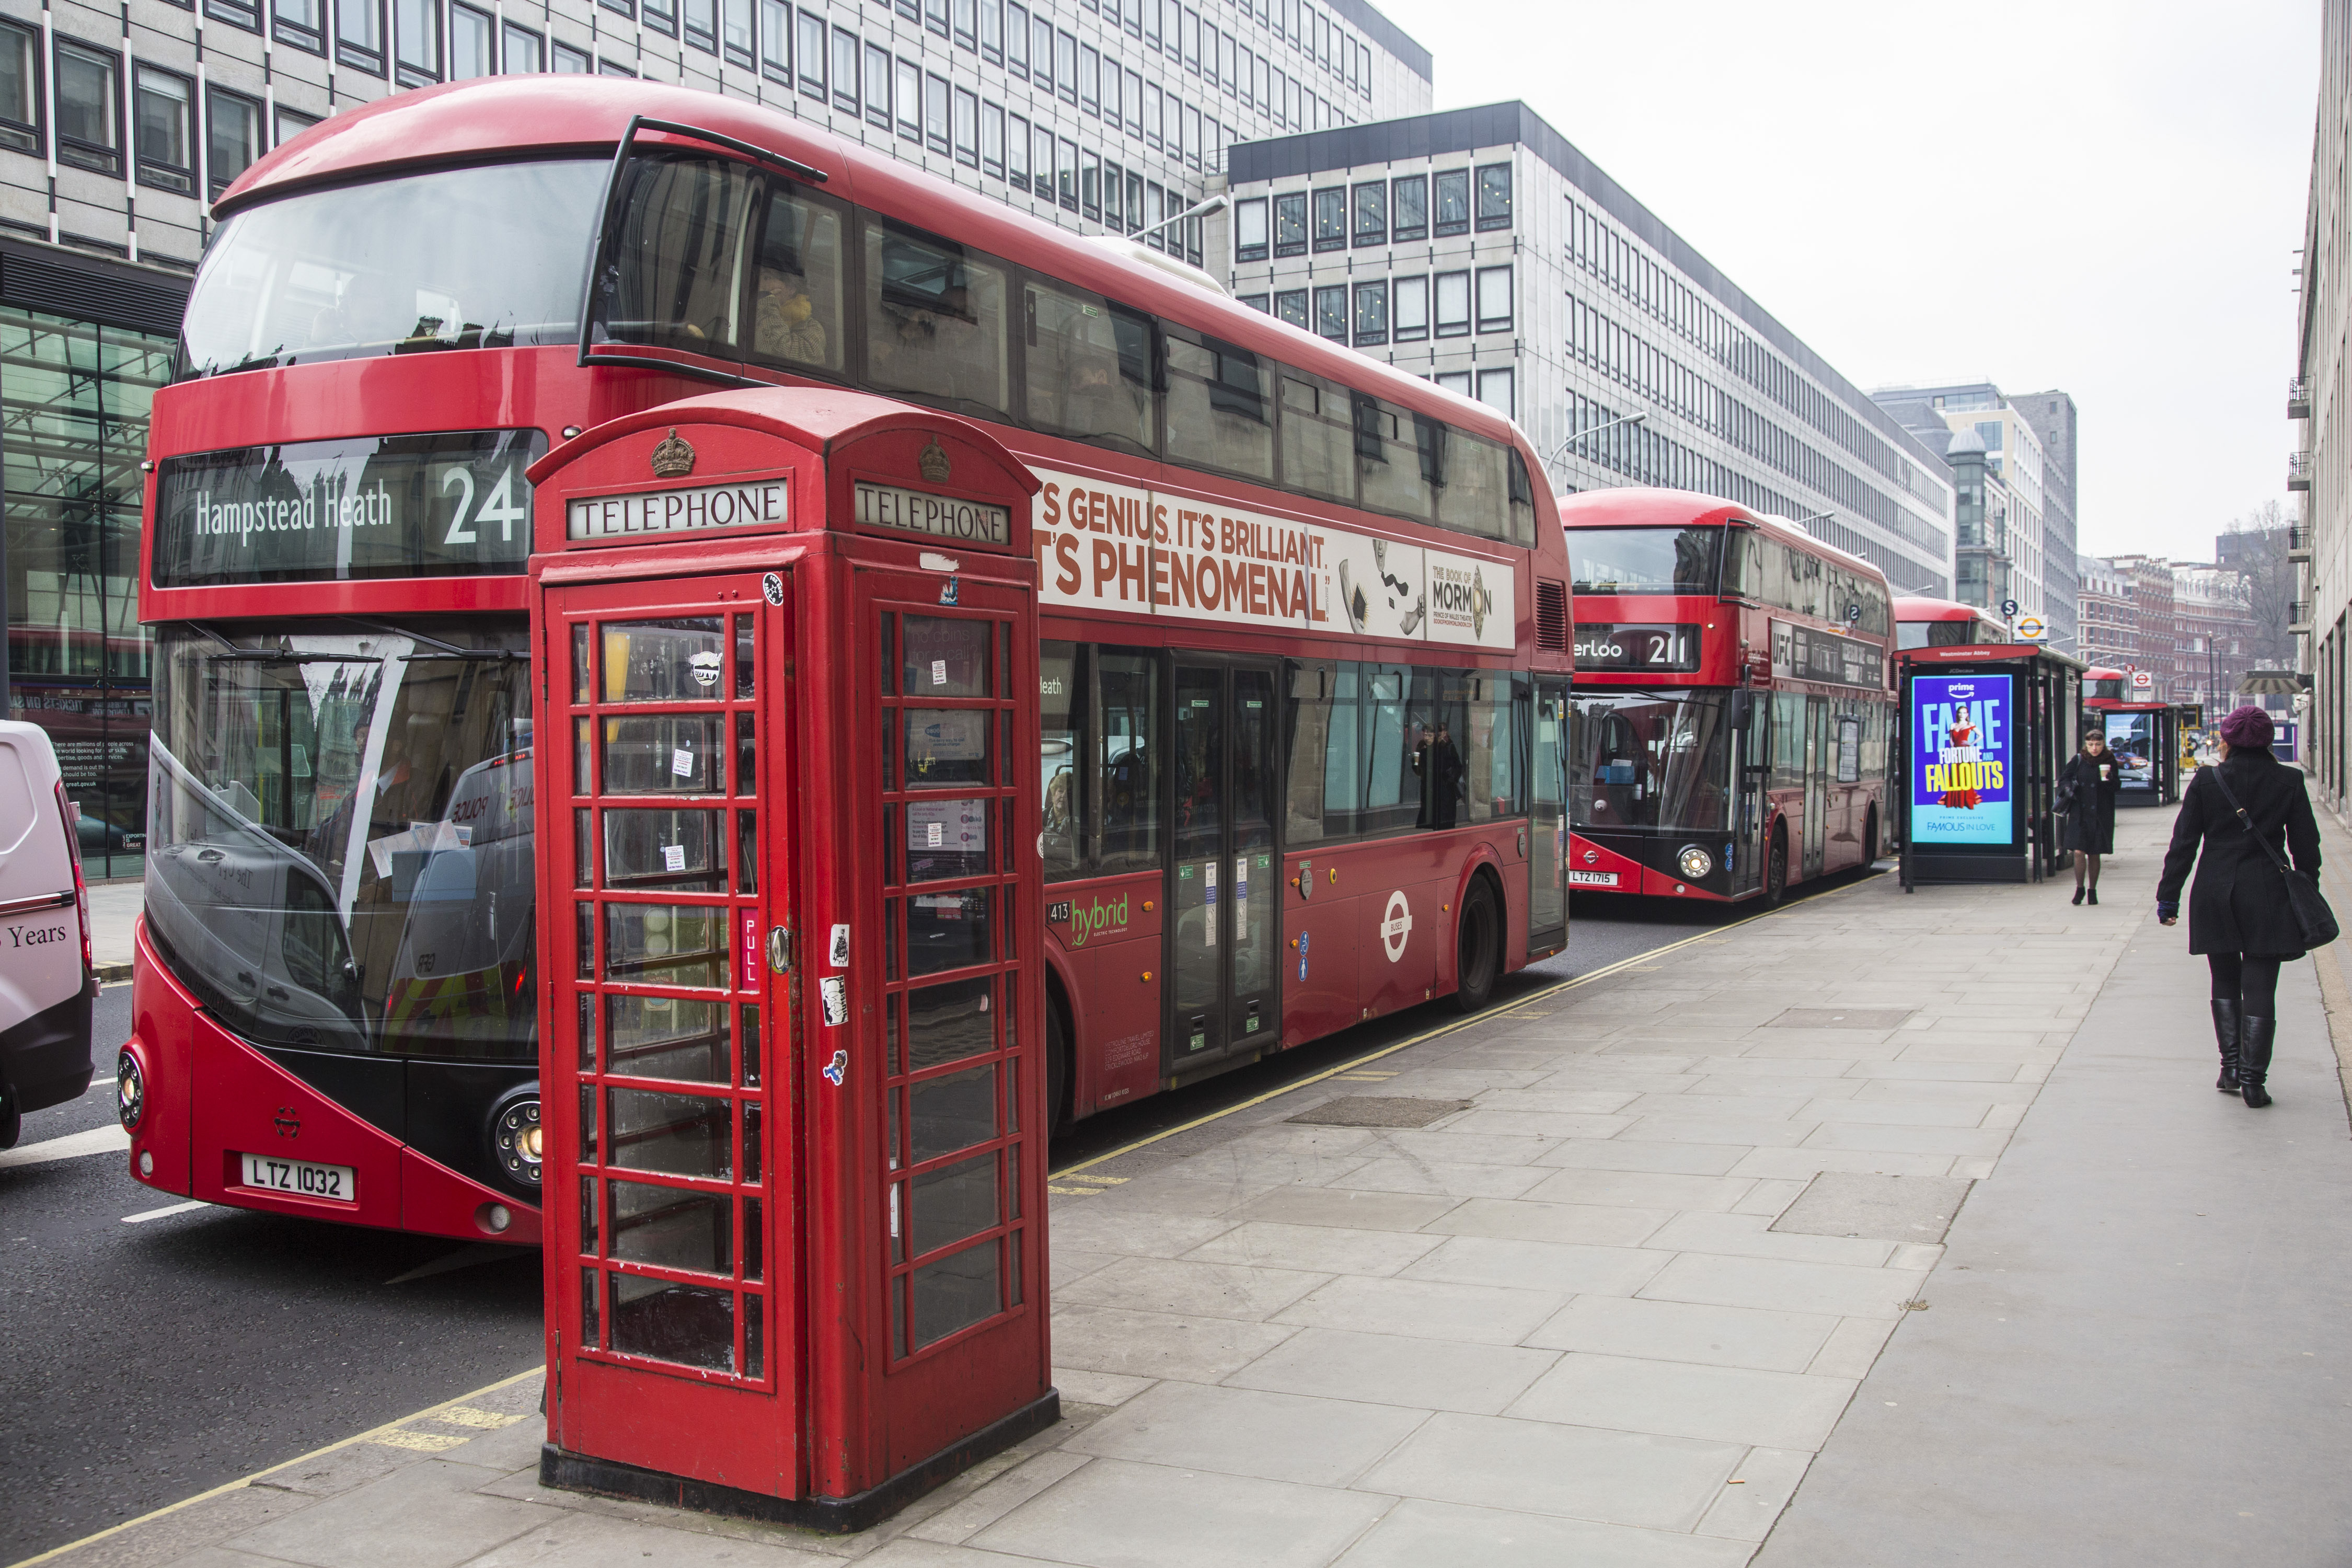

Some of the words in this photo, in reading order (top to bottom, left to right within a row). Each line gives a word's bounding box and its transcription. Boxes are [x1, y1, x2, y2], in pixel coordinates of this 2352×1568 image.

[197, 490, 315, 547] Hampstead
[325, 479, 390, 528] Heath
[443, 464, 524, 544] 24
[577, 486, 780, 535] TELEPHONE
[857, 487, 1001, 542] TELEPHONE
[1068, 487, 1171, 545] GENIUS.
[1178, 509, 1215, 551] IT'S
[1221, 517, 1328, 570] BRILLIANT.
[1433, 566, 1444, 580] THE
[1446, 568, 1462, 583] BOOK
[1463, 572, 1471, 584] OF
[2005, 602, 2014, 615] S
[1434, 618, 1472, 628] BOOKOFMORMONLONDON.COM
[913, 631, 928, 643] no
[933, 627, 970, 642] coins
[913, 648, 930, 662] for
[1650, 636, 1685, 663] 211
[1773, 632, 1791, 666] UFC
[1949, 683, 1974, 693] prime
[1922, 699, 2002, 753] FAME
[1939, 746, 1982, 764] FORTUNE
[1982, 752, 1993, 761] AND
[1925, 760, 2004, 792] FALLOUTS
[1928, 822, 1965, 832] FAMOUS
[1573, 872, 1590, 882] LTZ
[1593, 873, 1610, 883] 1715
[1051, 904, 1068, 920] 413
[1072, 892, 1127, 946] hybrid
[1391, 921, 1402, 932] BUSES
[7, 926, 66, 948] Years
[747, 920, 755, 981] PULL
[1104, 1037, 1126, 1049] METROLINE
[1127, 1034, 1140, 1043] TRAVEL
[1140, 1030, 1154, 1039] LIMITED
[1138, 1038, 1150, 1047] HOUSE
[1113, 1051, 1131, 1061] EDGWARE
[1134, 1054, 1143, 1063] NW2
[253, 1159, 291, 1189] LTZ
[297, 1166, 340, 1195] 1032
